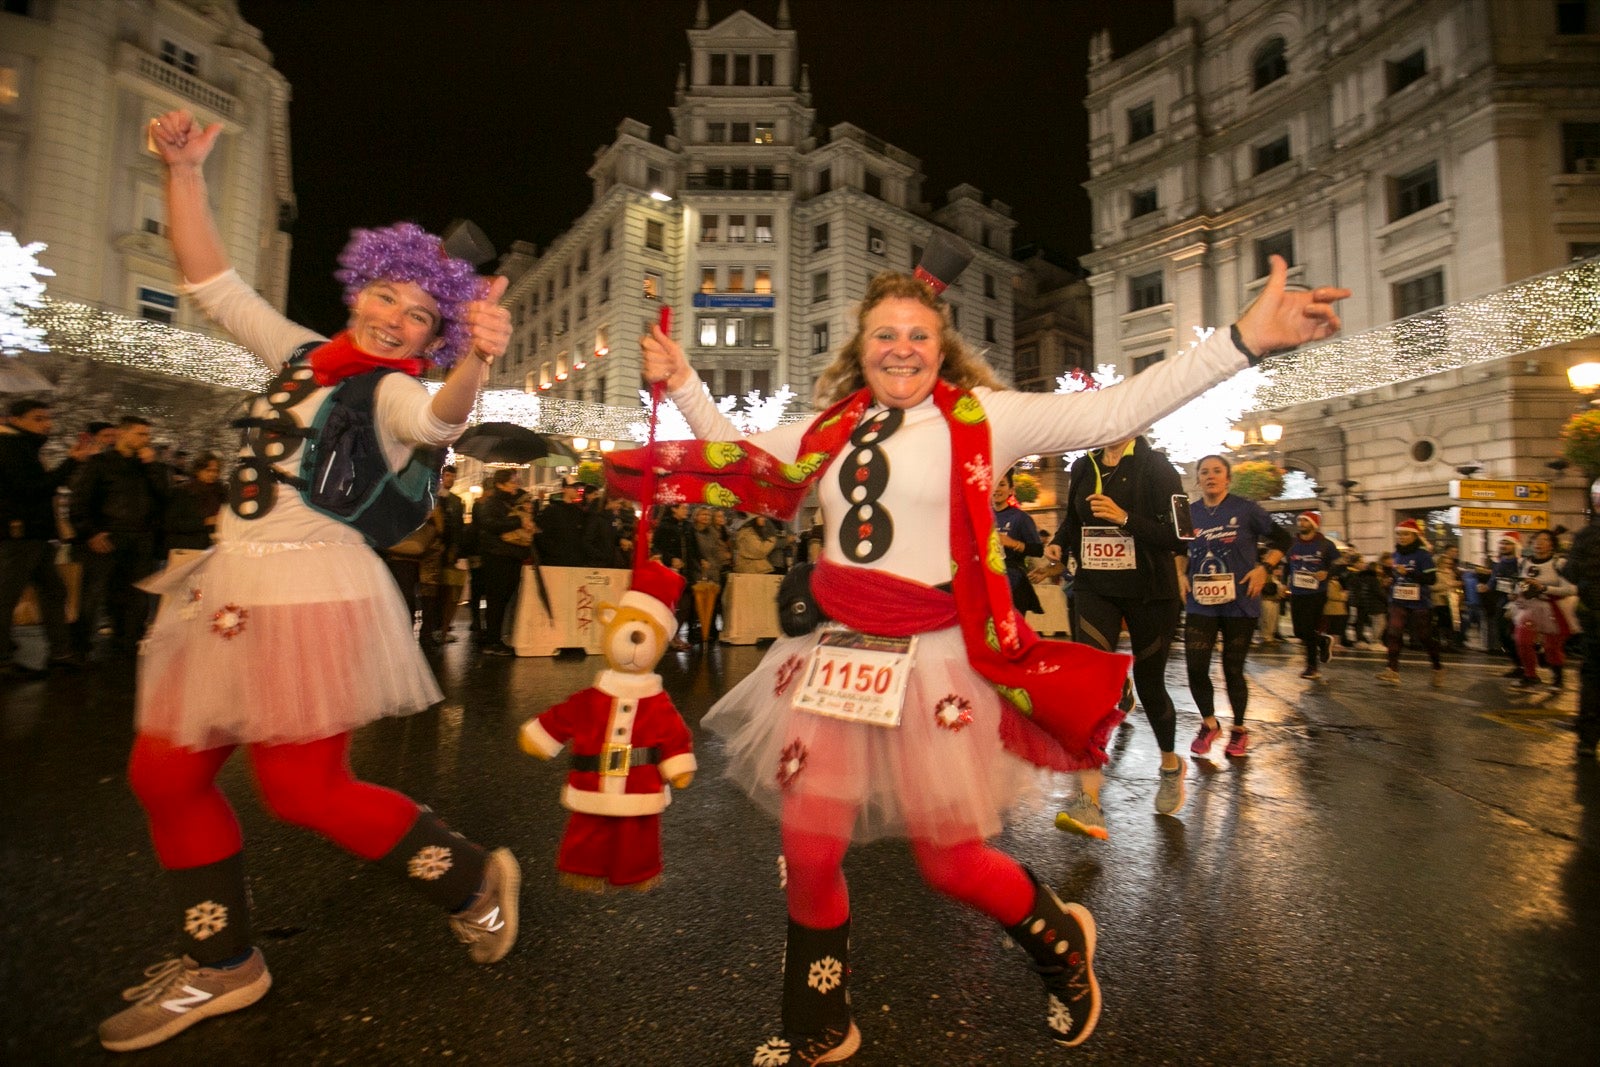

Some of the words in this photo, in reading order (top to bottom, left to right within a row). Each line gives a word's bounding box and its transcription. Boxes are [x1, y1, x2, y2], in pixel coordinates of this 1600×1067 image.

[1460, 509, 1489, 517] Oficina
[1460, 517, 1492, 525] Turismo
[1086, 543, 1126, 557] 1502
[1197, 585, 1227, 596] 2001
[821, 660, 894, 695] 1150
